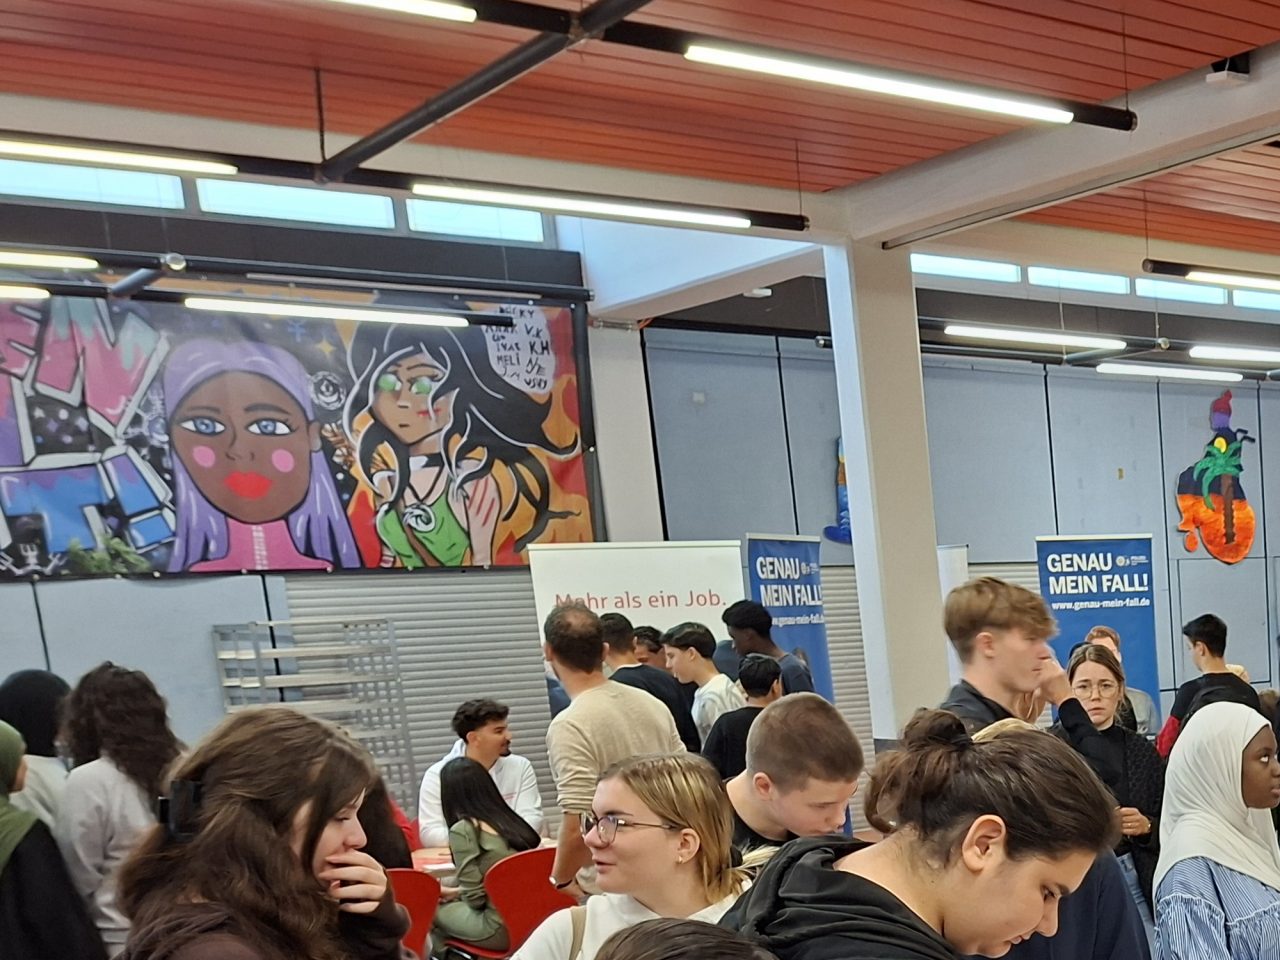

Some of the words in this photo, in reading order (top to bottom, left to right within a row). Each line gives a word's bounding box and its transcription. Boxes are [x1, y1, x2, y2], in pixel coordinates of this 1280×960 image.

[756, 556, 800, 580] GENAU
[1046, 553, 1113, 573] GENAU
[1048, 575, 1098, 594] MEIN
[1101, 573, 1149, 592] FALL!
[614, 591, 642, 609] als
[648, 590, 678, 608] ein
[685, 589, 727, 607] Job.
[760, 584, 793, 607] MEIN
[1051, 597, 1151, 611] www.genau-mein-fall.de
